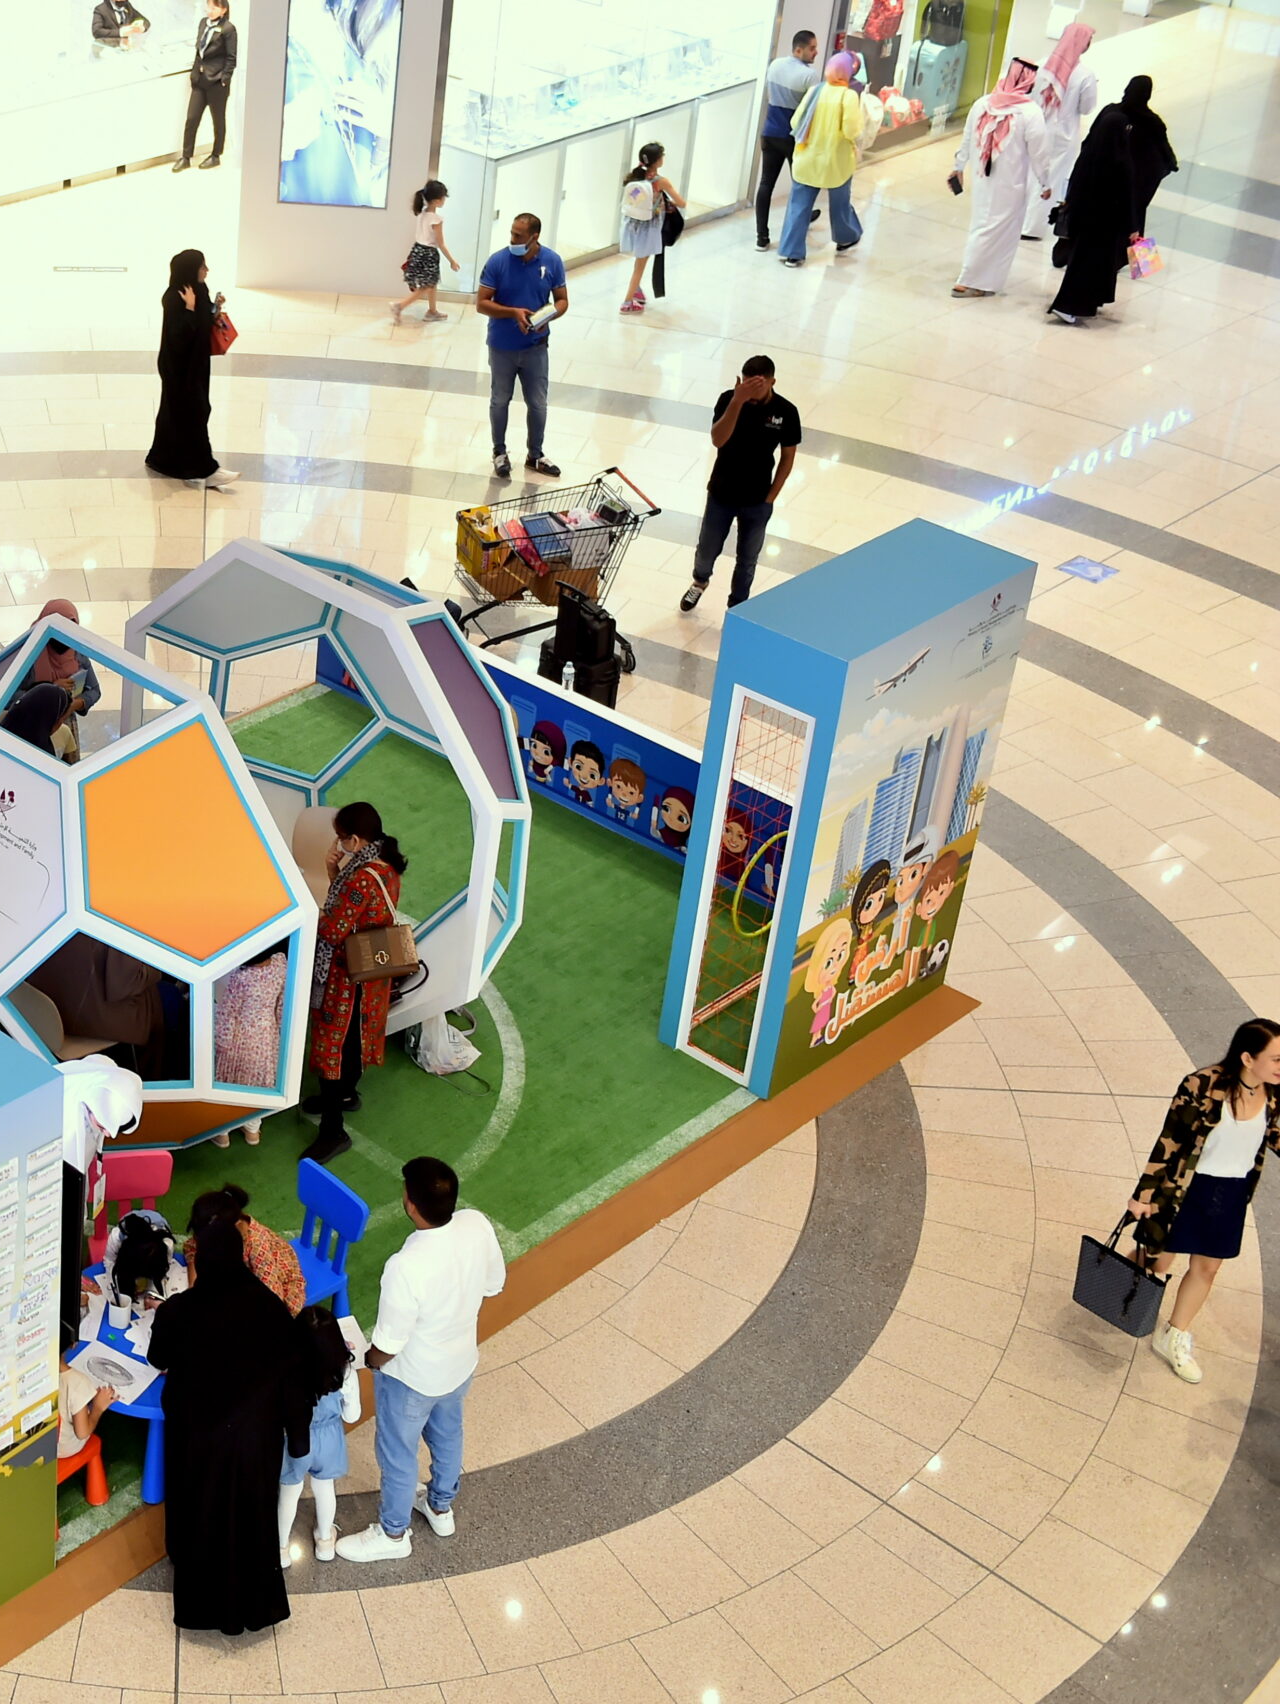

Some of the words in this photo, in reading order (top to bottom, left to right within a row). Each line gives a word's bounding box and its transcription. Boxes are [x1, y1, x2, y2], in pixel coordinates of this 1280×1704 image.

[617, 811, 626, 821] 12
[20, 846, 36, 859] Family
[825, 946, 922, 1044] المستقبل
